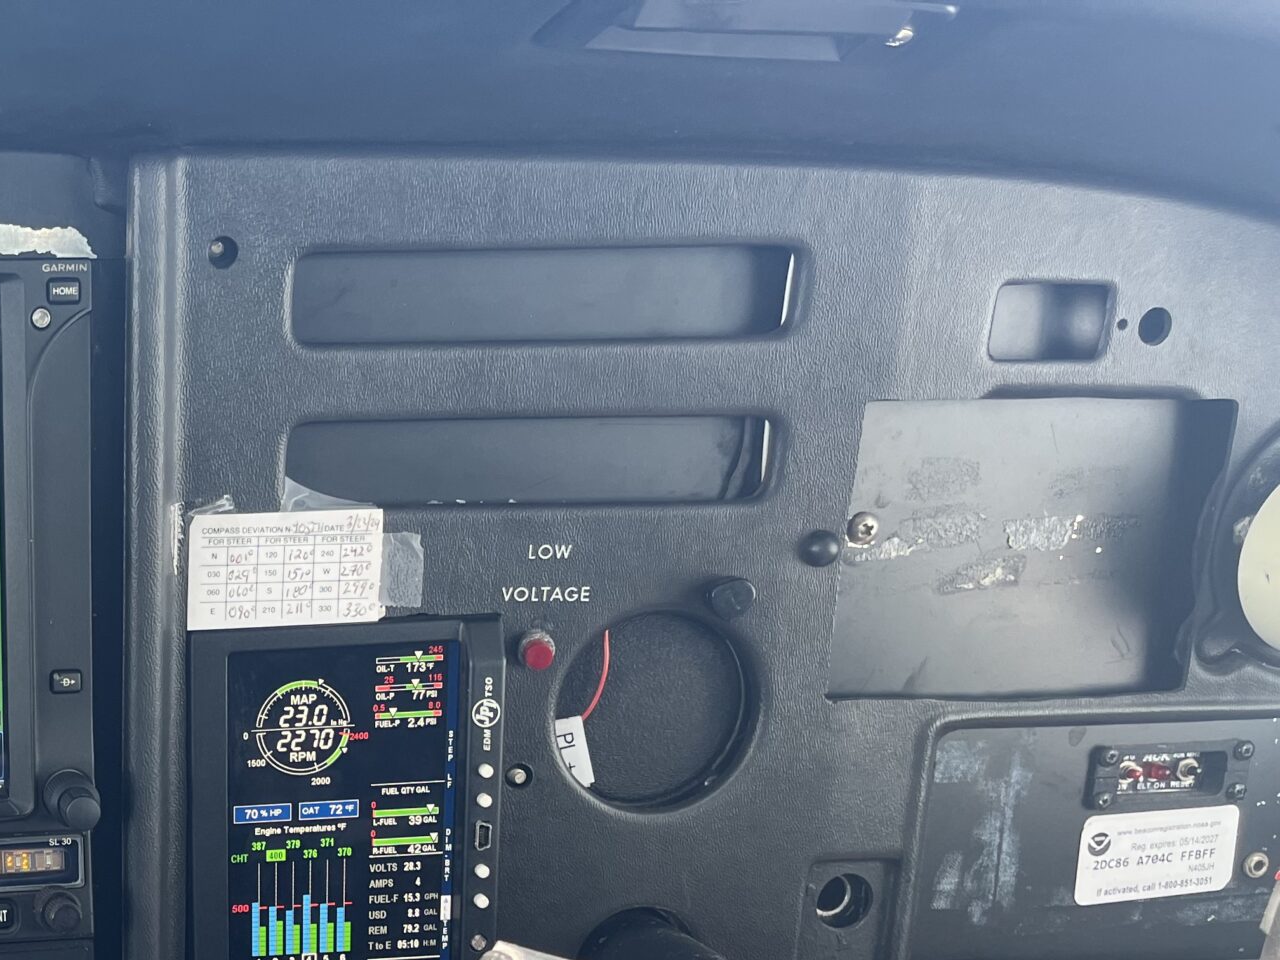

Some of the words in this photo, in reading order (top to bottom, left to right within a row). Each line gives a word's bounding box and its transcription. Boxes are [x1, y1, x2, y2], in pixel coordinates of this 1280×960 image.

[42, 264, 87, 272] GARMIN
[53, 287, 78, 295] HOME
[528, 544, 572, 559] LOW
[502, 587, 591, 602] VOLTAGE
[291, 694, 317, 705] MAP
[280, 705, 328, 727] 23.0
[277, 728, 334, 752] 2270
[483, 729, 491, 751] EDM
[290, 752, 316, 762] RPM
[382, 787, 399, 795] FUEL
[255, 827, 281, 835] Engine
[284, 824, 336, 834] Temperatures
[231, 854, 248, 863] CHT
[1093, 858, 1129, 870] 2DC86
[1181, 848, 1216, 861] FFBFF
[369, 863, 397, 872] VOLTS
[404, 861, 421, 871] 28.3
[369, 879, 393, 888] AMPS
[1104, 885, 1140, 896] activated,
[1142, 883, 1156, 892] call
[369, 894, 398, 904] FUEL-F
[369, 910, 386, 919] USD
[369, 926, 387, 935] REM
